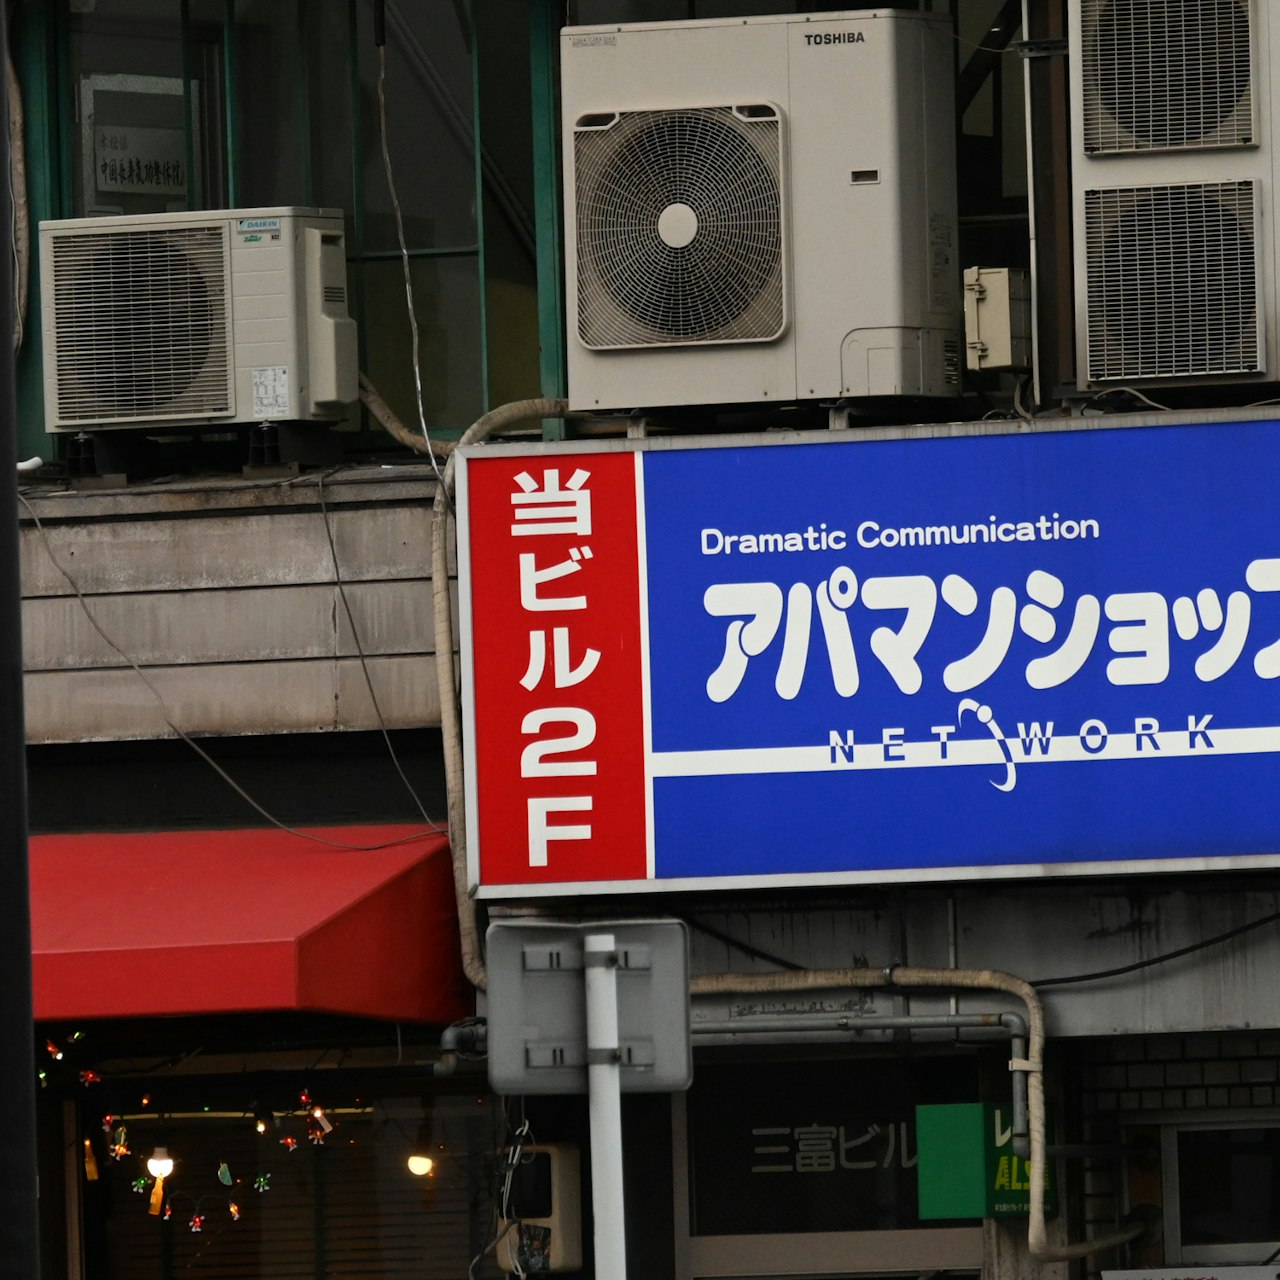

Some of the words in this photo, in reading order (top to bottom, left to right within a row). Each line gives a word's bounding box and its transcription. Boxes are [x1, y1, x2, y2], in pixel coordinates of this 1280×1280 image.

[804, 32, 865, 45] TOSHIBA
[247, 220, 278, 228] DAIKIN
[701, 523, 847, 556] Dramatic
[856, 512, 1100, 550] Communication
[510, 468, 602, 868] 当ビル2F
[752, 1121, 917, 1173] 三富ビル
